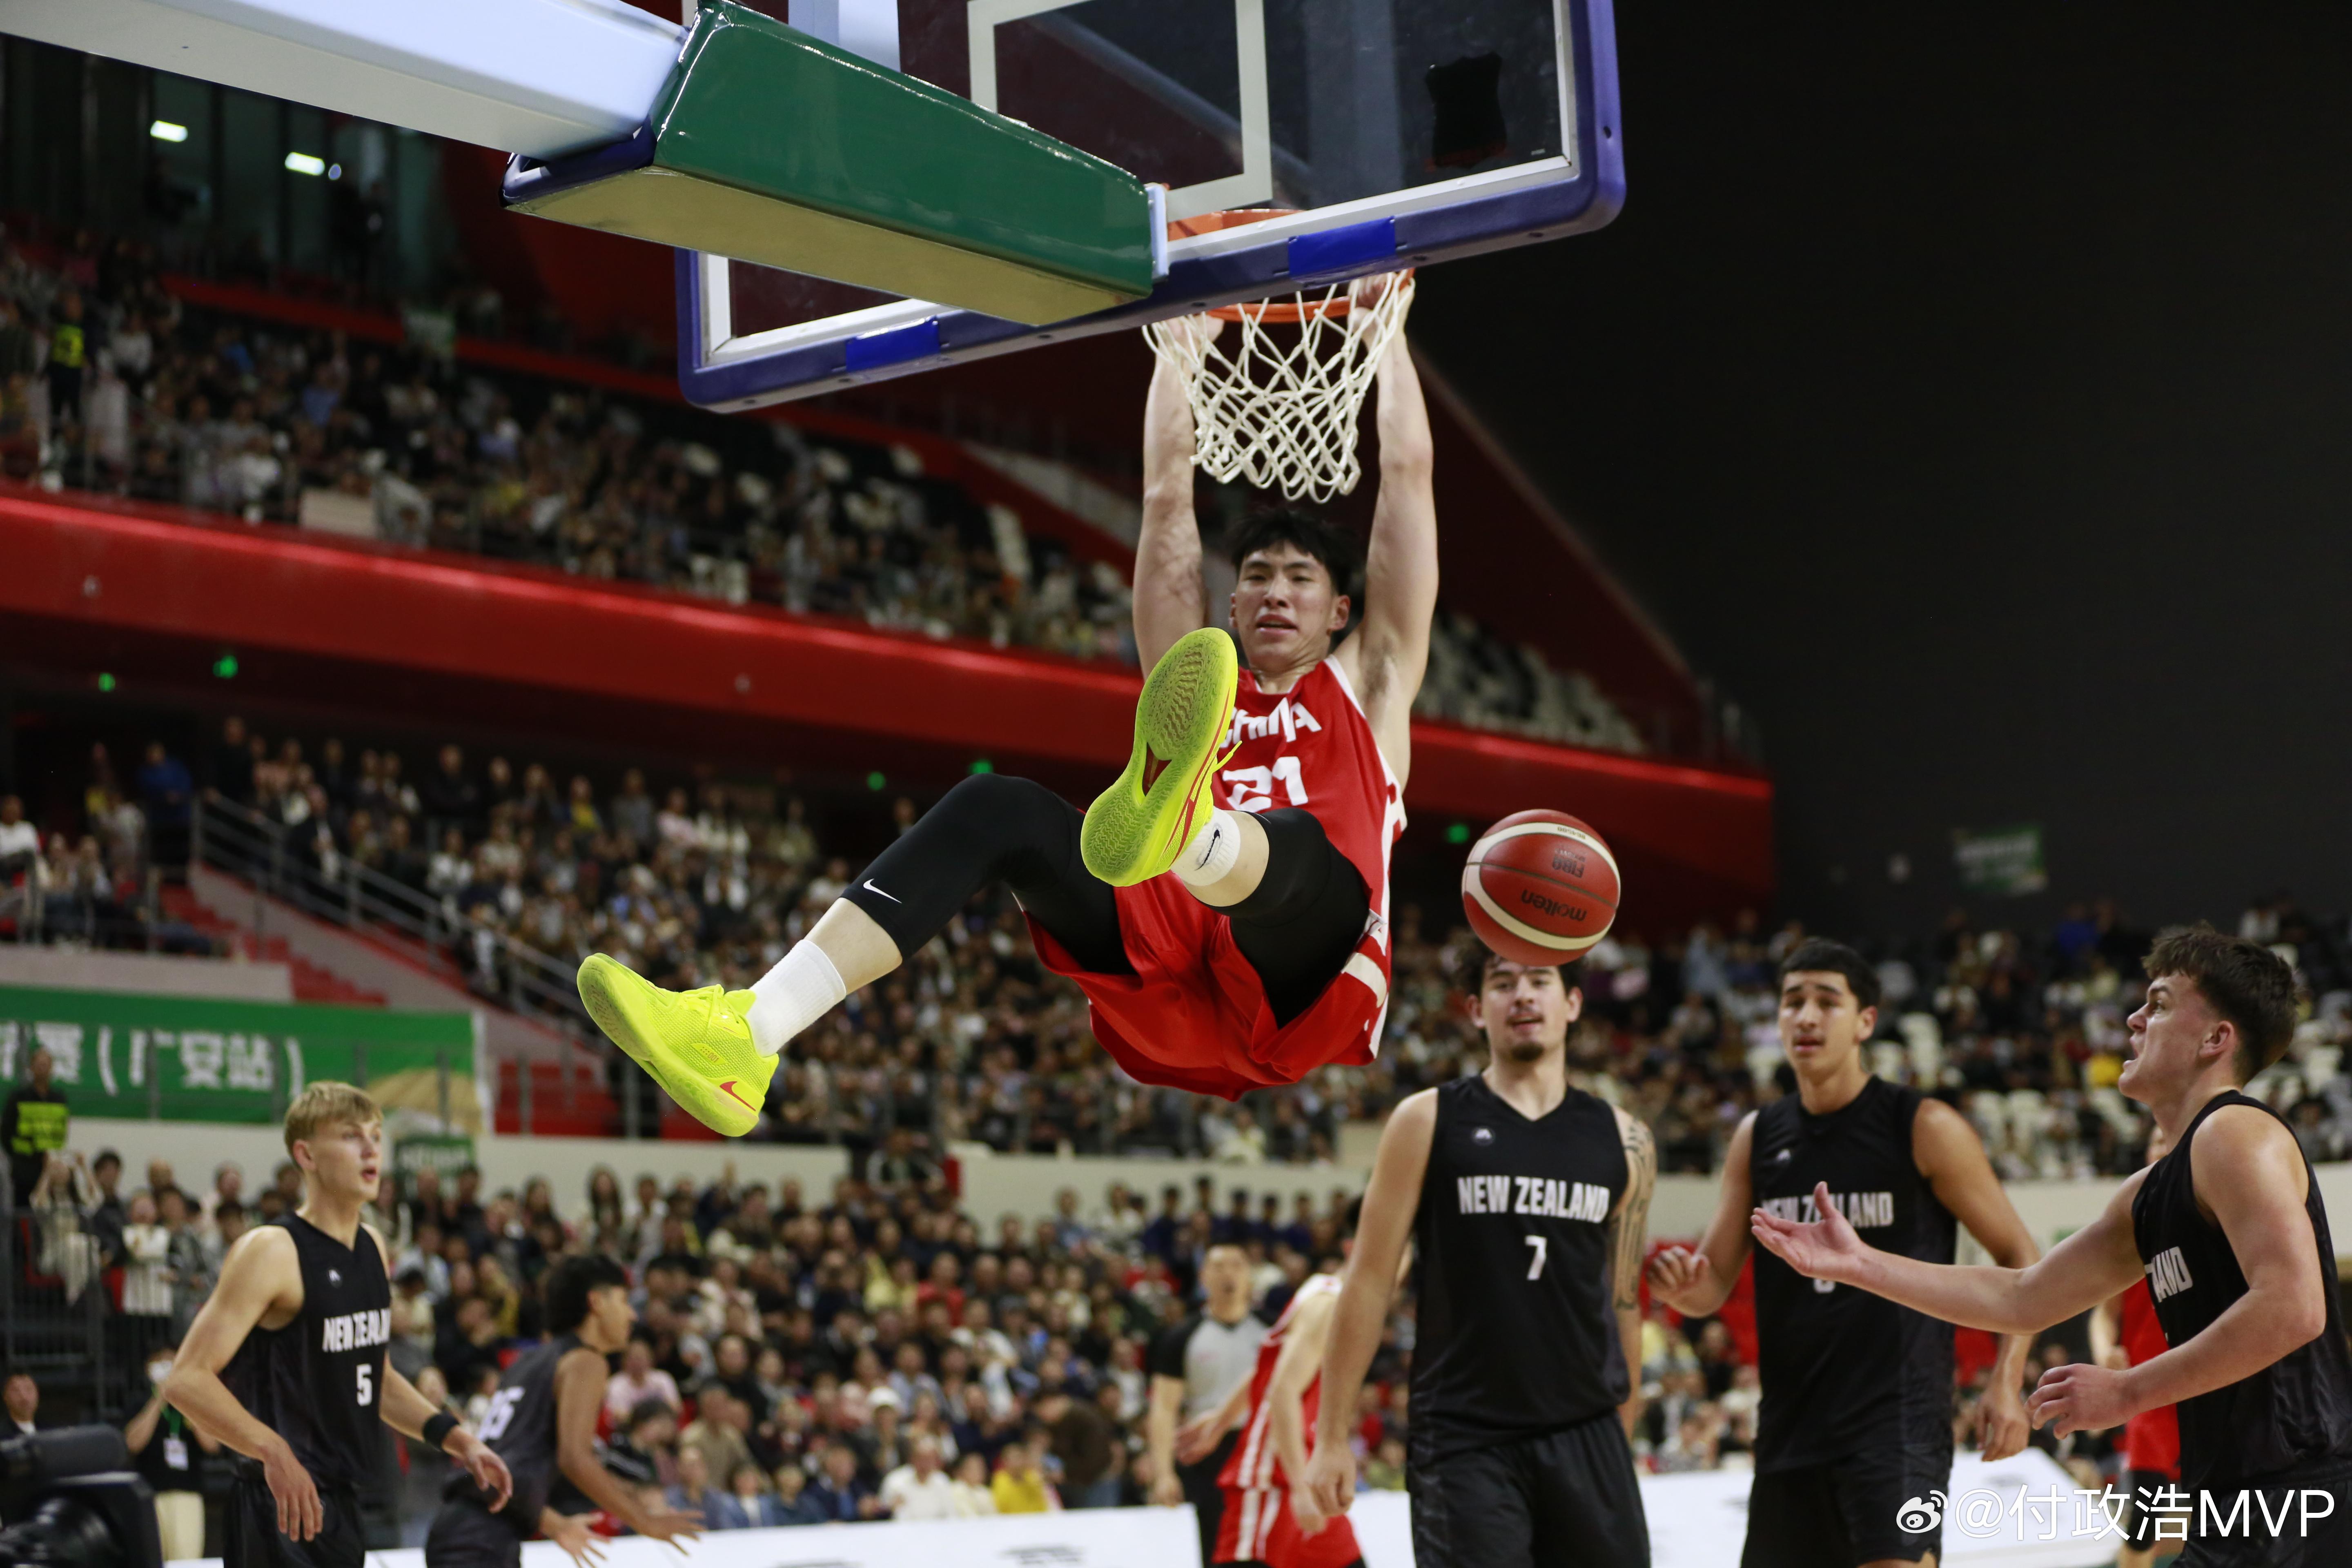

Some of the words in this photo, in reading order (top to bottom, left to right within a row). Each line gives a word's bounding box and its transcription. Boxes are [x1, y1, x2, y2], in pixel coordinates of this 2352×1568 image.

[1222, 756, 1309, 813] 21
[1552, 856, 1585, 879] FIBA
[1521, 889, 1588, 922] molten
[1457, 1175, 1510, 1214] NEW
[1515, 1176, 1610, 1224] ZEALAND
[1525, 1234, 1547, 1281] 7
[322, 1314, 354, 1353] NEW
[356, 1363, 372, 1406] 5
